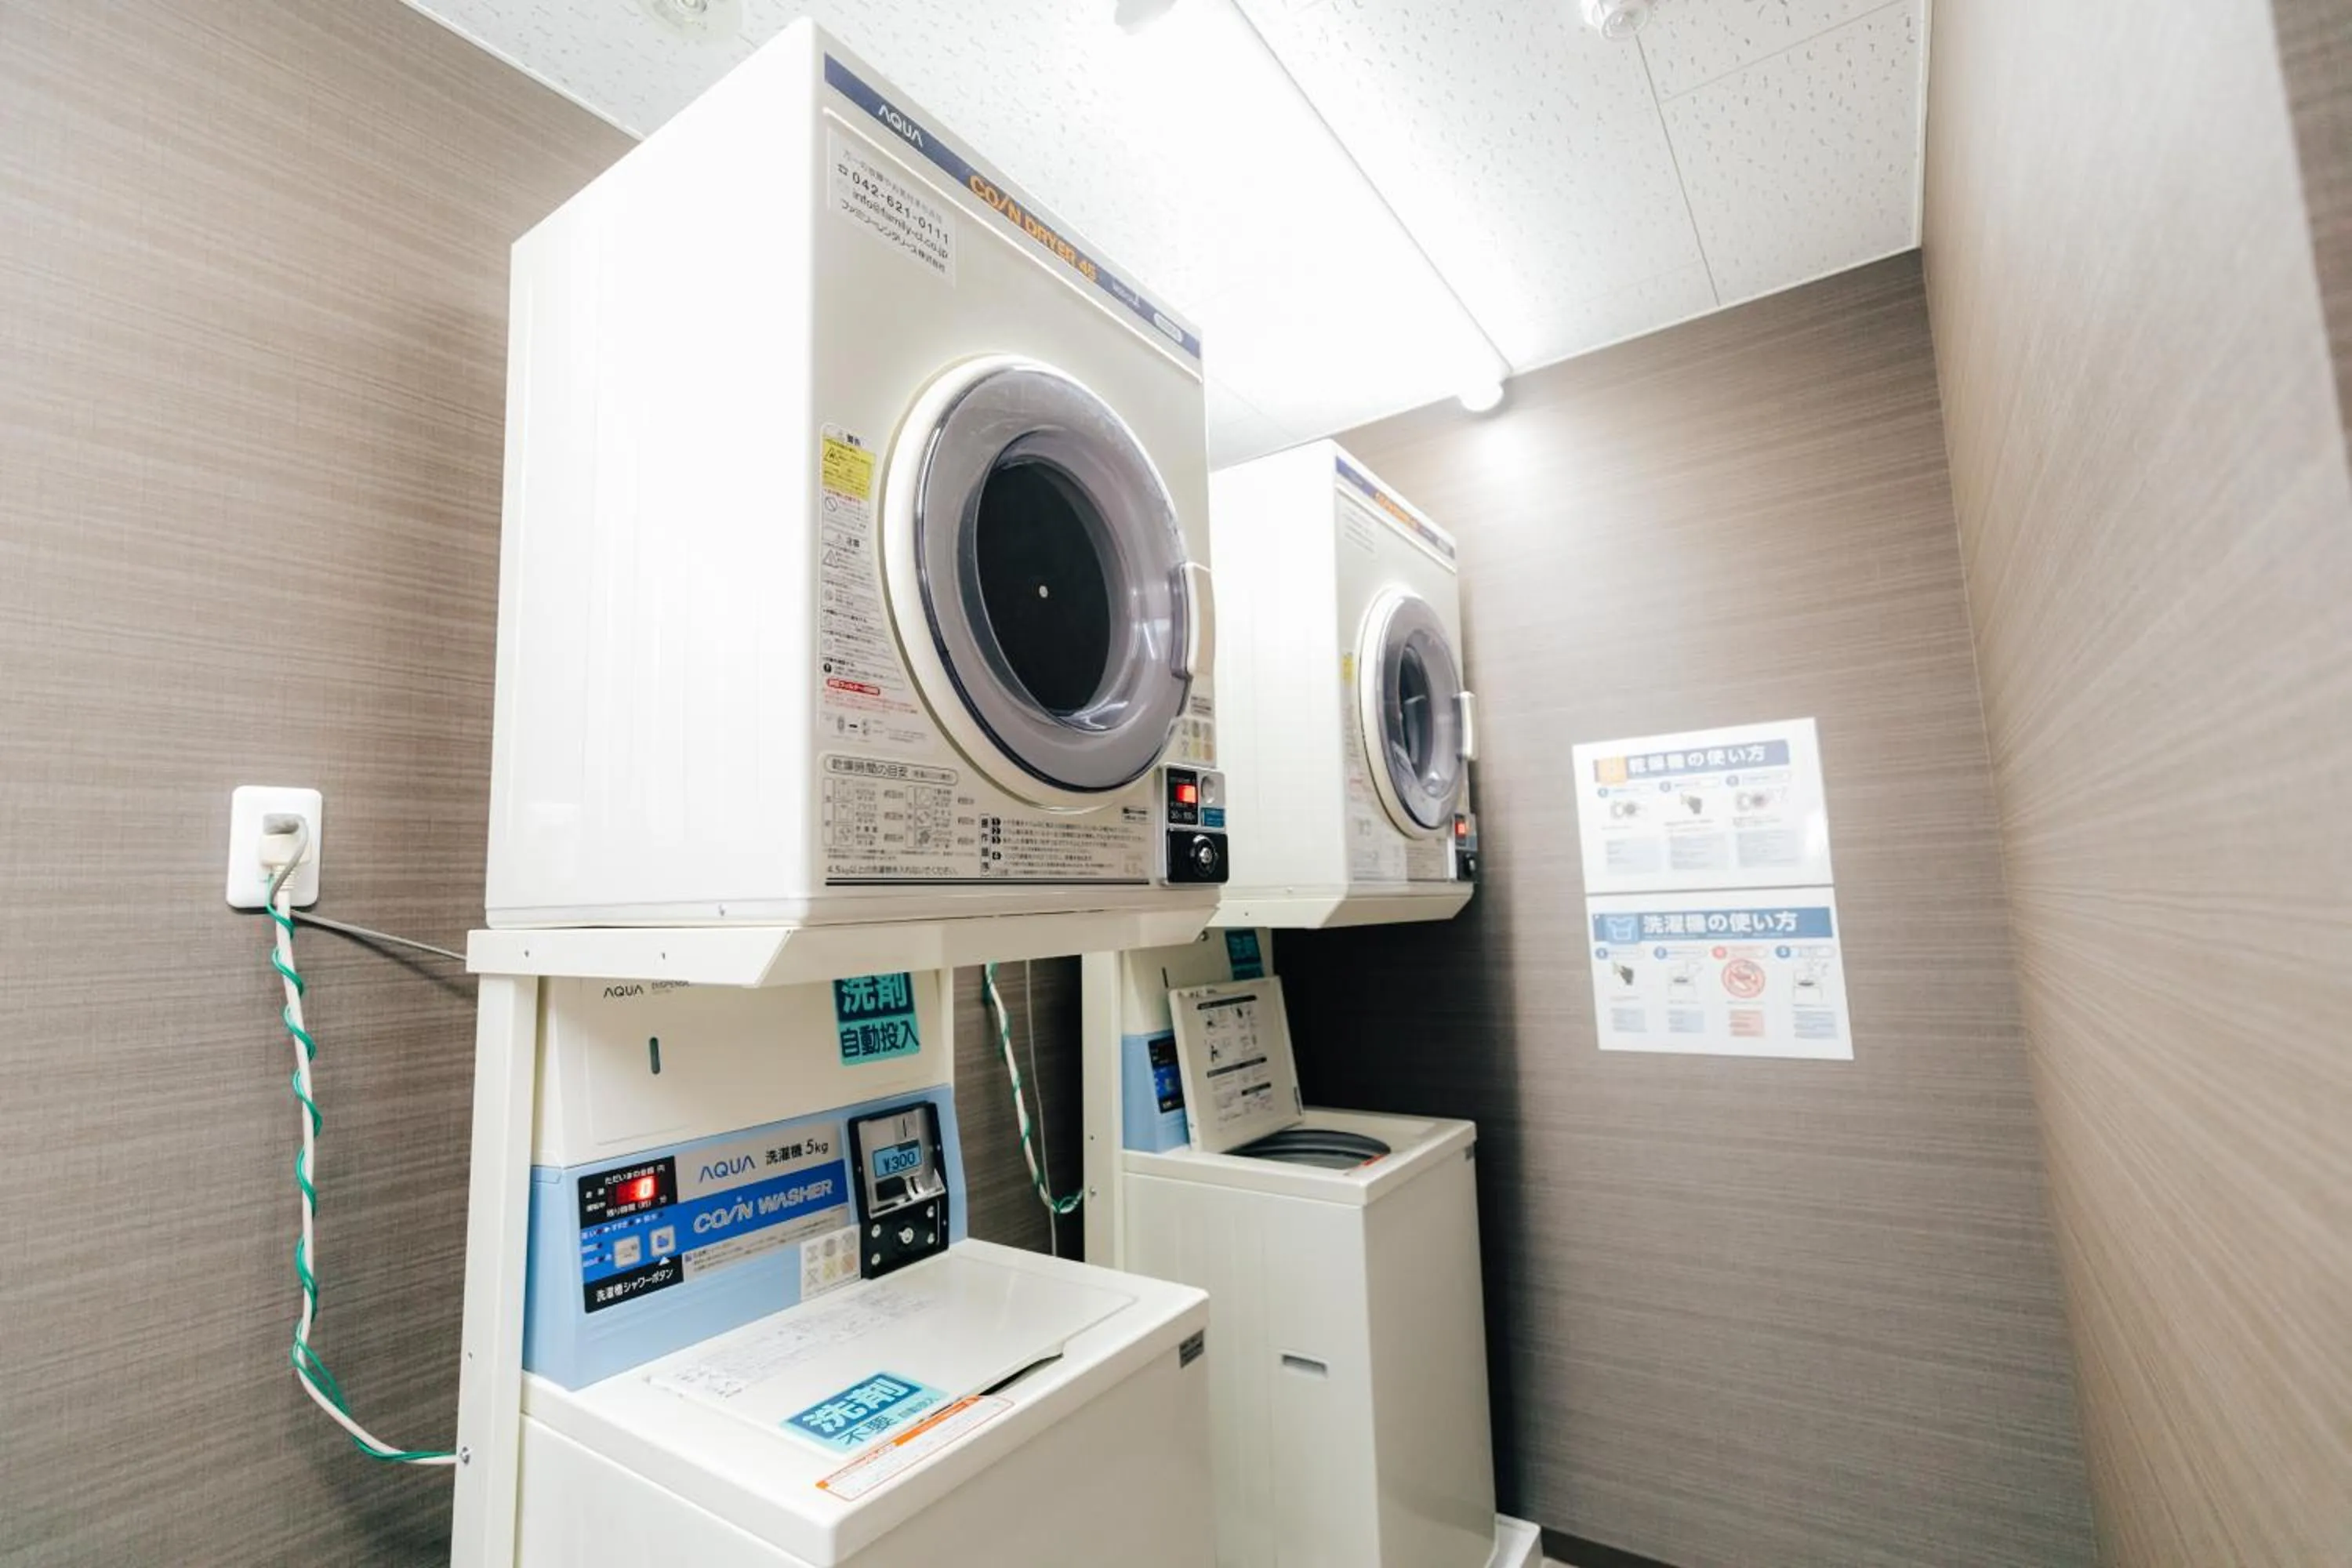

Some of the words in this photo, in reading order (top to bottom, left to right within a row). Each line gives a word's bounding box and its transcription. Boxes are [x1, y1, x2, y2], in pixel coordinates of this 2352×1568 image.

[878, 103, 924, 148] AQUA
[851, 171, 949, 246] 042-621-0111
[1025, 214, 1076, 265] DRYER
[1643, 910, 1798, 934] 洗濯機の使い方
[603, 984, 644, 998] AQUA
[841, 974, 909, 1014] 洗剤
[840, 1020, 920, 1058] 自動投入
[698, 1154, 757, 1184] AQUA
[764, 1143, 804, 1166] 洗濯機
[805, 1138, 829, 1156] 5kg
[882, 1150, 916, 1174] ¥300
[757, 1178, 834, 1216] WASHER
[801, 1377, 908, 1433] 洗剤
